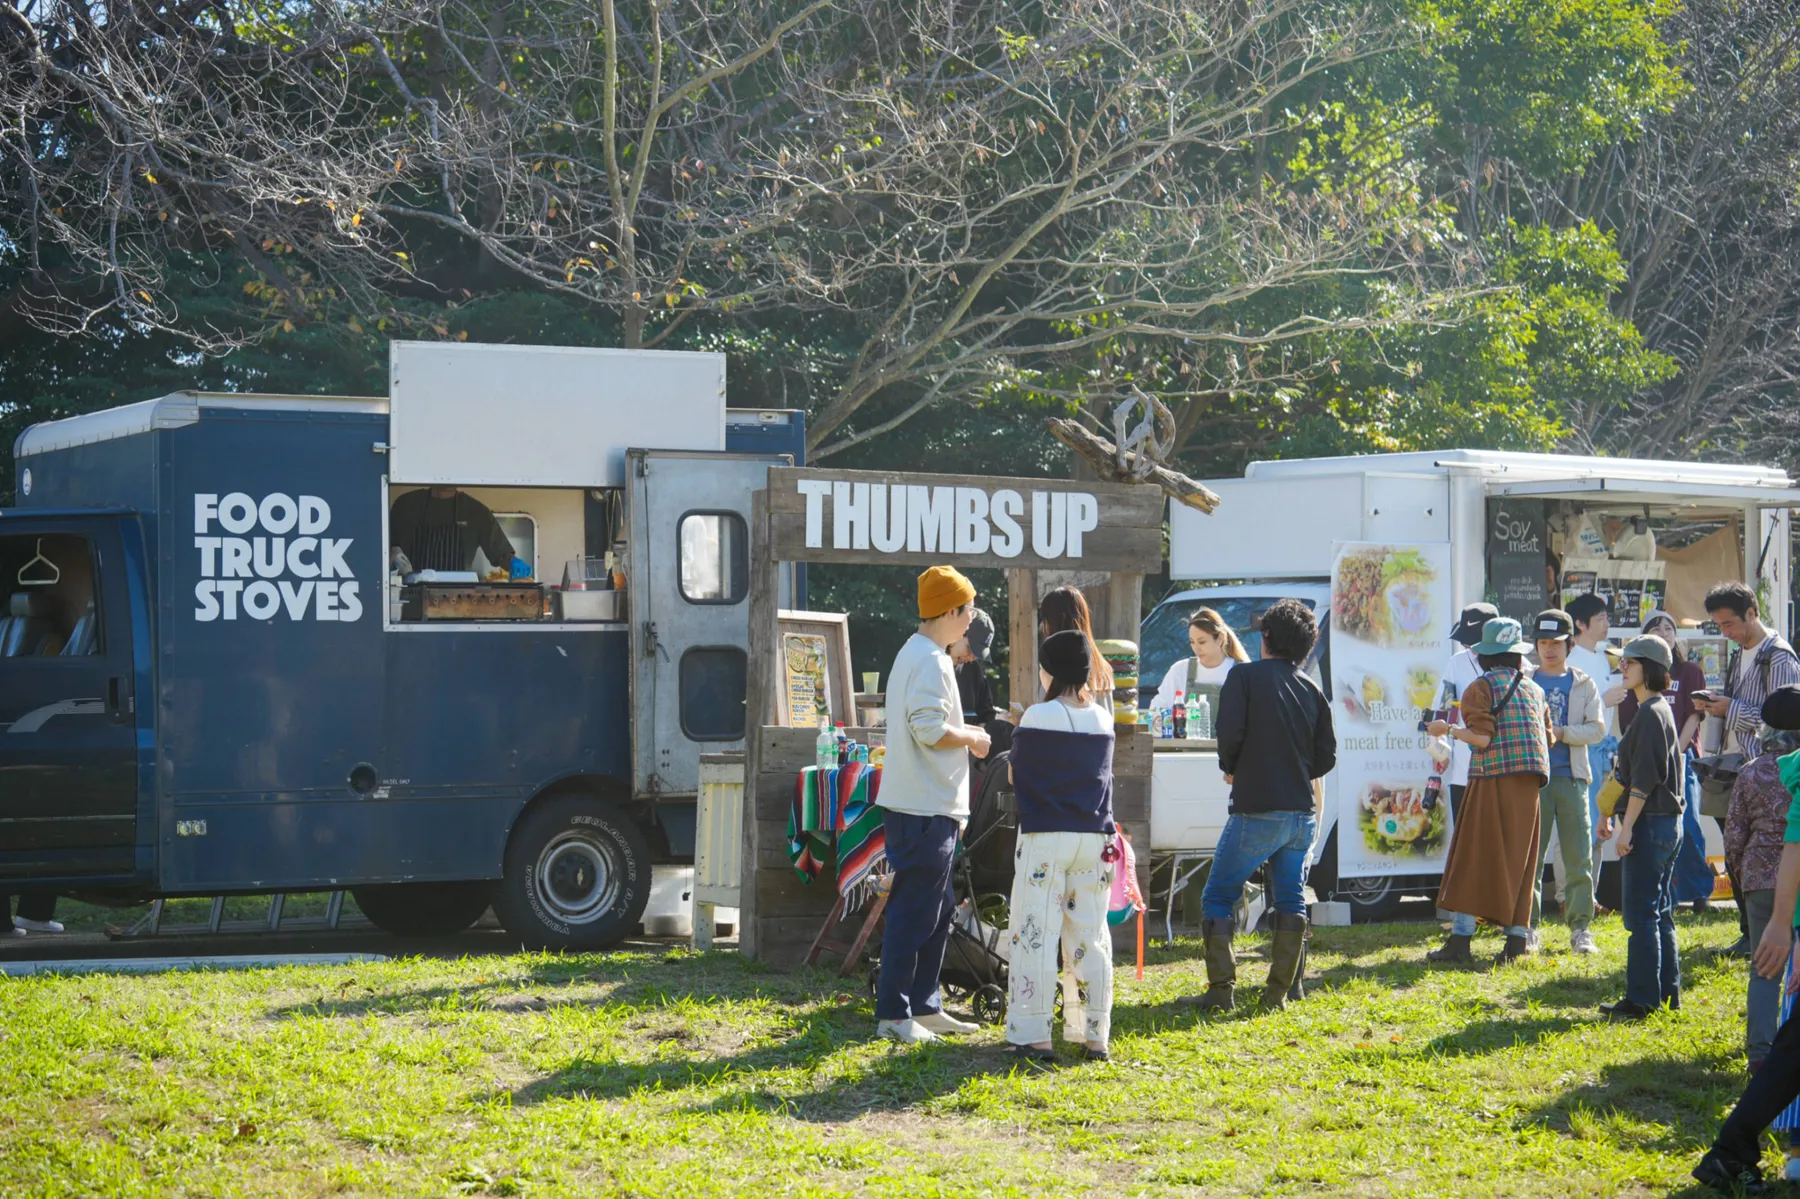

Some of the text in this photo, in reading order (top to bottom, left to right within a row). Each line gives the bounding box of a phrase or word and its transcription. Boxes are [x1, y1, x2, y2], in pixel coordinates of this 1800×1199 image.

[194, 491, 332, 535] FOOD
[797, 479, 1098, 559] THUMBS UP
[1495, 511, 1531, 541] Soy
[194, 536, 356, 578] TRUCK
[1509, 534, 1539, 553] meat
[194, 579, 363, 622] STOVES
[1371, 702, 1423, 721] Have a
[1345, 734, 1379, 751] meat
[1385, 731, 1412, 750] free
[571, 816, 637, 882] GEOLANDAR
[525, 864, 570, 935] YOKOHAMA
[617, 887, 634, 919] A/T
